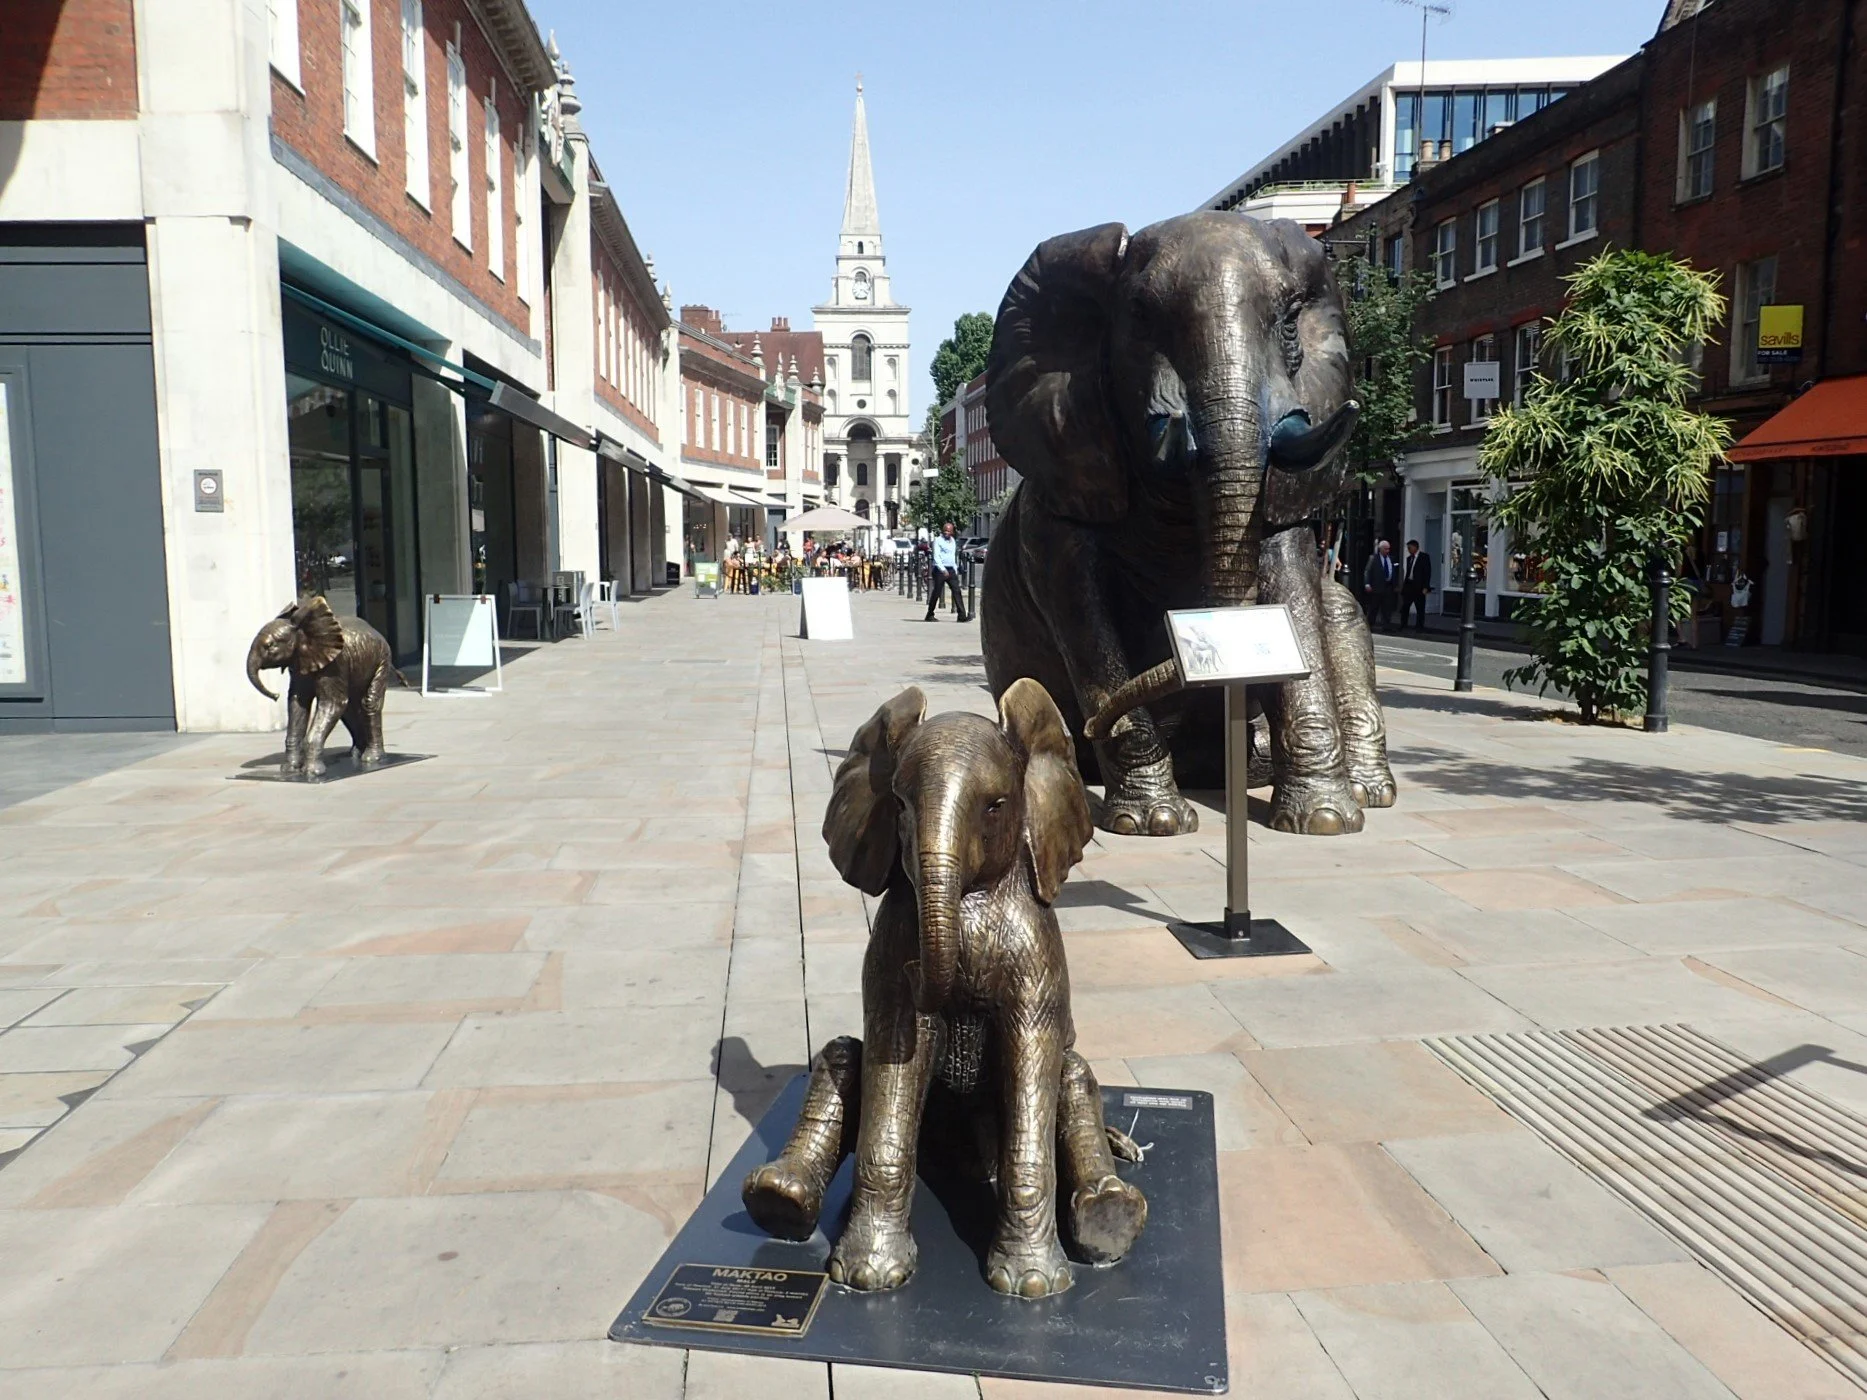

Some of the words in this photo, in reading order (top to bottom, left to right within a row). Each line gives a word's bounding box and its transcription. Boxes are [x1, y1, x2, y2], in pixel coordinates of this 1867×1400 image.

[320, 326, 350, 356] OLLIE
[1760, 331, 1800, 346] savills
[320, 350, 354, 379] QUINN
[712, 1268, 788, 1282] MAKTAO
